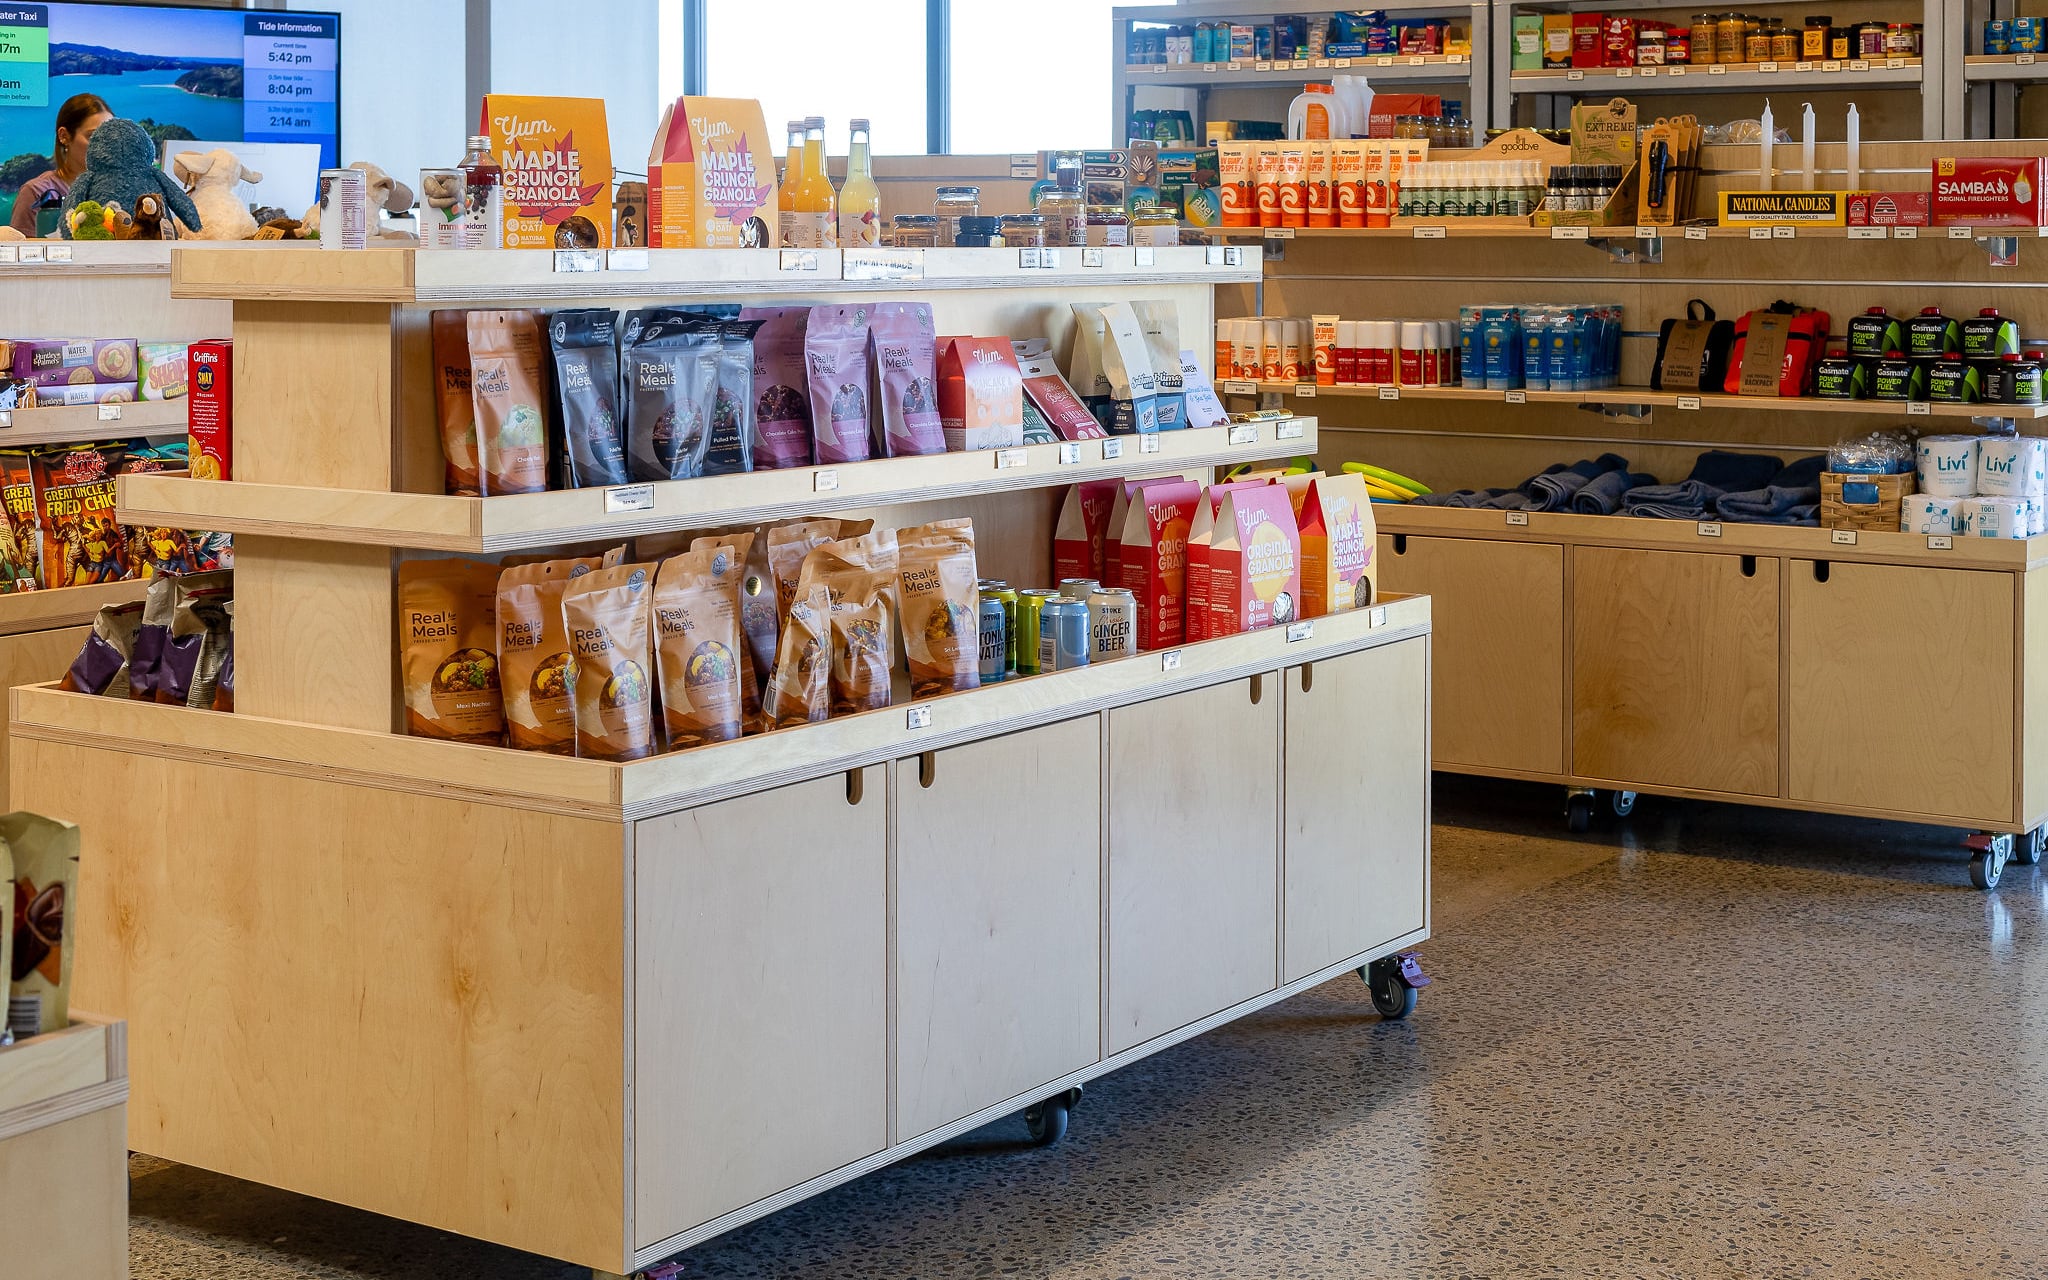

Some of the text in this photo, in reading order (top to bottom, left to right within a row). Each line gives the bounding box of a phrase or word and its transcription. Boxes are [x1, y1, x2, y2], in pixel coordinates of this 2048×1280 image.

[0, 12, 37, 21] ater Taxi
[259, 22, 322, 32] Tide Information
[268, 52, 312, 64] 5:42 pm
[268, 84, 312, 97] 8:04 pm
[270, 117, 292, 126] 2:14
[1586, 122, 1634, 132] EXTREME
[1501, 142, 1539, 154] goodbye
[502, 150, 579, 171] MAPLE
[702, 151, 754, 172] MAPLE
[503, 171, 580, 187] CRUNCH
[703, 171, 756, 188] CRUNCH
[503, 187, 580, 201] GRANOLA
[704, 187, 756, 202] GRANOLA
[1939, 182, 1996, 194] SAMBA
[1135, 197, 1155, 208] abel
[1195, 197, 1215, 217] abel
[1733, 198, 1830, 211] NATIONAL CANDLES
[1853, 323, 1881, 331] Gasmate
[68, 346, 87, 355] WATER
[885, 348, 905, 357] Real
[194, 352, 218, 364] Griffin's
[812, 353, 829, 364] Real
[885, 358, 914, 369] Meals
[445, 366, 471, 377] Rea
[566, 363, 585, 376] Real
[640, 362, 668, 373] Real
[813, 364, 836, 374] Meals
[1819, 367, 1849, 375] Gasmate
[1931, 370, 1960, 378] Gasmate
[198, 372, 212, 385] SNAX
[477, 368, 499, 381] Real
[640, 374, 677, 385] Meals
[478, 381, 510, 394] Meals
[567, 375, 593, 388] Meals
[70, 392, 88, 400] WATER
[44, 485, 103, 502] GREAT UNCLE
[46, 493, 116, 517] FRIED CHIC
[1149, 503, 1181, 530] Yum.
[1238, 507, 1270, 534] Yum.
[1331, 520, 1364, 543] MAPLE
[1247, 539, 1294, 560] ORIGINAL
[1332, 538, 1365, 555] CRUNCH
[1158, 555, 1186, 571] GRAN
[1248, 556, 1294, 576] GRANOLA
[1333, 553, 1365, 567] GRANOLA
[903, 569, 928, 582] Real
[782, 577, 800, 590] Rea
[905, 578, 940, 593] Meals
[412, 611, 445, 624] Real
[661, 608, 684, 621] Real
[413, 624, 457, 637] Meals
[506, 619, 533, 634] Real
[575, 624, 605, 642] Real
[662, 620, 695, 634] Meals
[1093, 622, 1130, 638] GINGER
[505, 632, 543, 648] Meals
[979, 628, 1003, 645] TONIC
[577, 638, 615, 655] Meals
[1099, 637, 1124, 652] BEER
